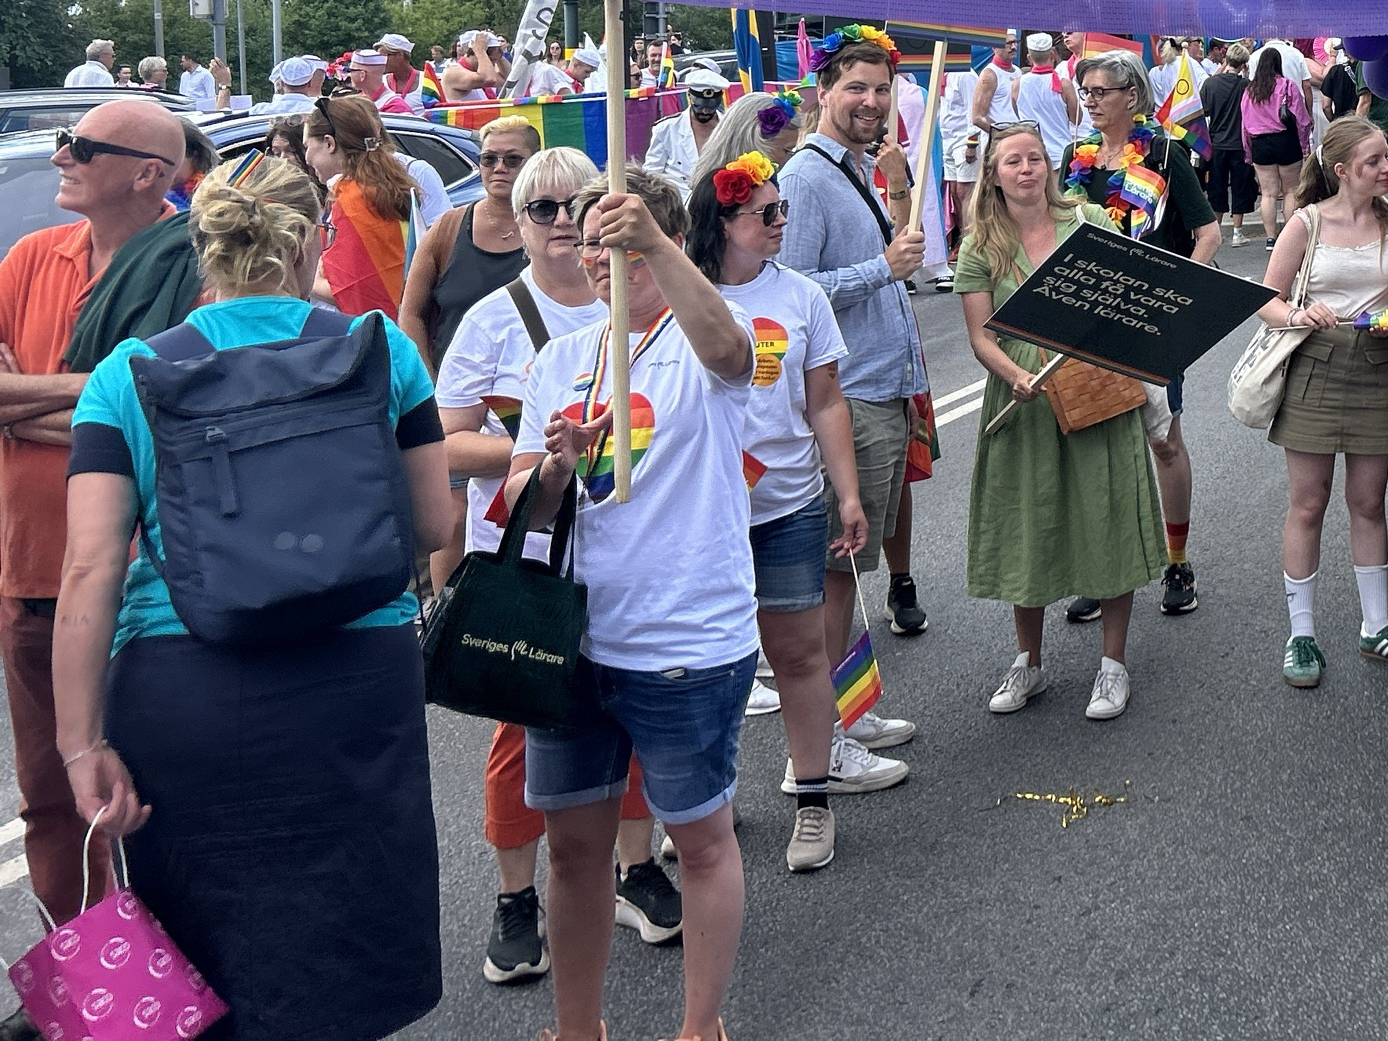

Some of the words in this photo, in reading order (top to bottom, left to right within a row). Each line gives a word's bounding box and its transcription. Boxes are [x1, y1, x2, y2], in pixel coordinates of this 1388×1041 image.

[1086, 232, 1129, 252] Sveriges
[1144, 254, 1178, 269] Lärare
[1042, 276, 1078, 293] sig
[1080, 288, 1149, 318] själva.
[1053, 265, 1097, 285] alla
[1099, 279, 1125, 295] få
[1130, 291, 1180, 314] vara
[1063, 253, 1075, 263] I
[1074, 259, 1149, 290] skolan
[1152, 286, 1194, 306] ska
[1032, 282, 1091, 311] Även
[1094, 304, 1163, 336] lärare.
[461, 633, 509, 653] Sveriges
[528, 646, 565, 664] Lärare
